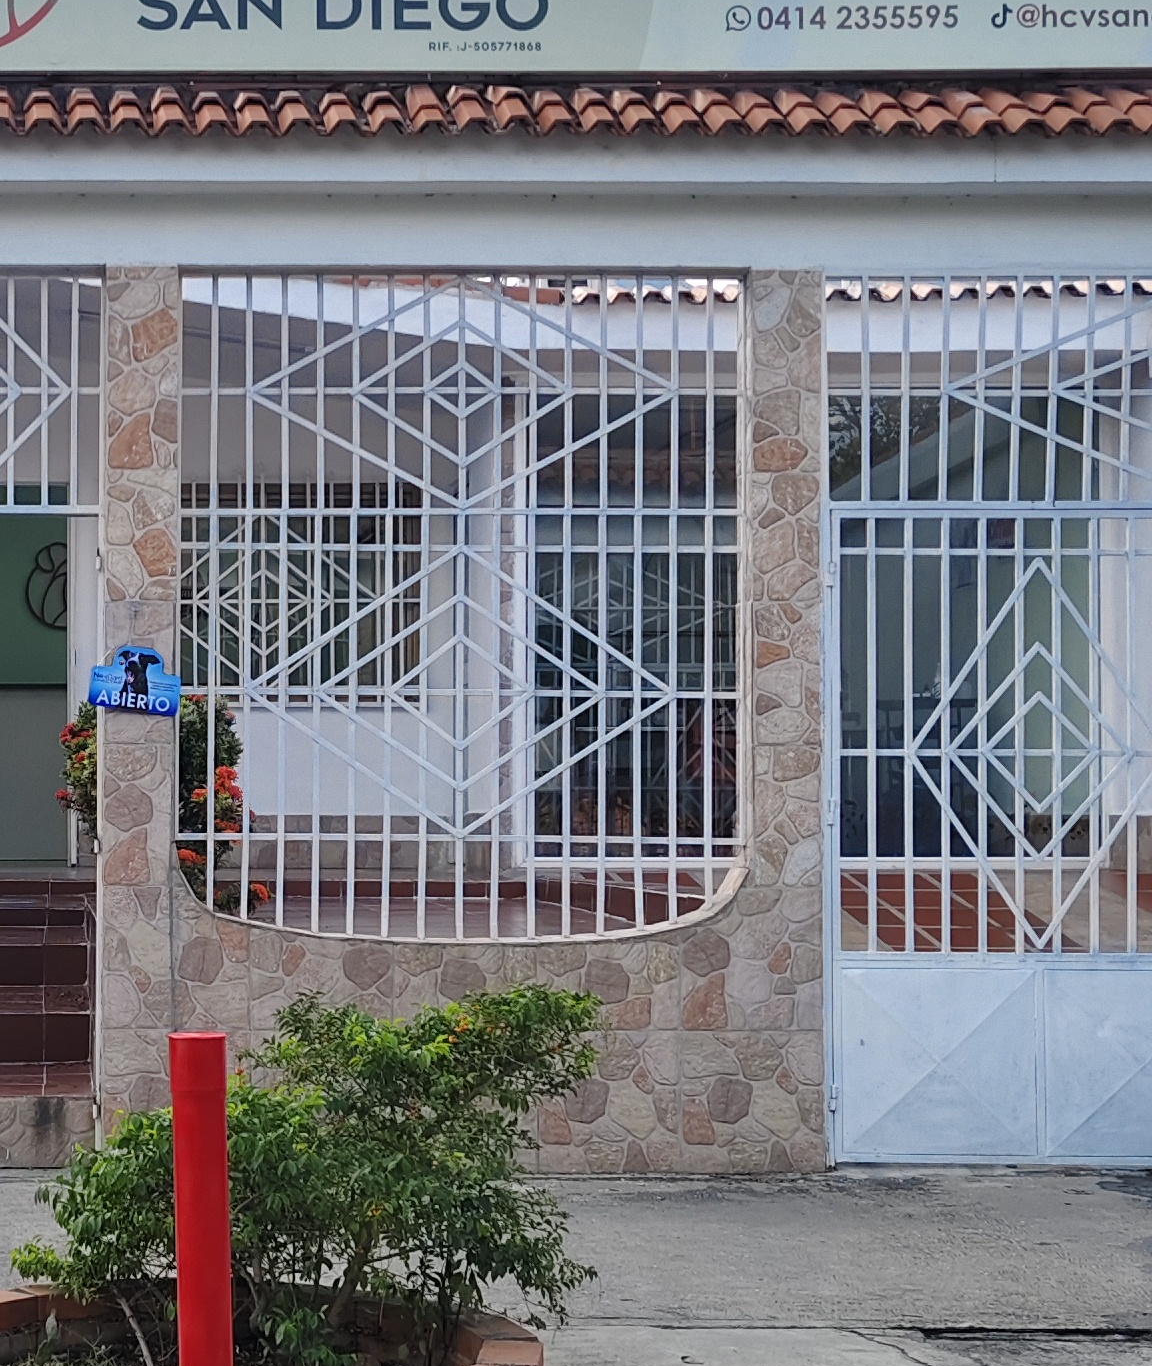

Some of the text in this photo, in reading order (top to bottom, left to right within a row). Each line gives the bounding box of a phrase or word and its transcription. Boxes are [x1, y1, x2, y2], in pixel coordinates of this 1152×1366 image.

[757, 2, 1152, 31] 0414 2355595 @hcvsan
[428, 41, 452, 52] RIF.
[95, 688, 170, 712] ABIERTO
